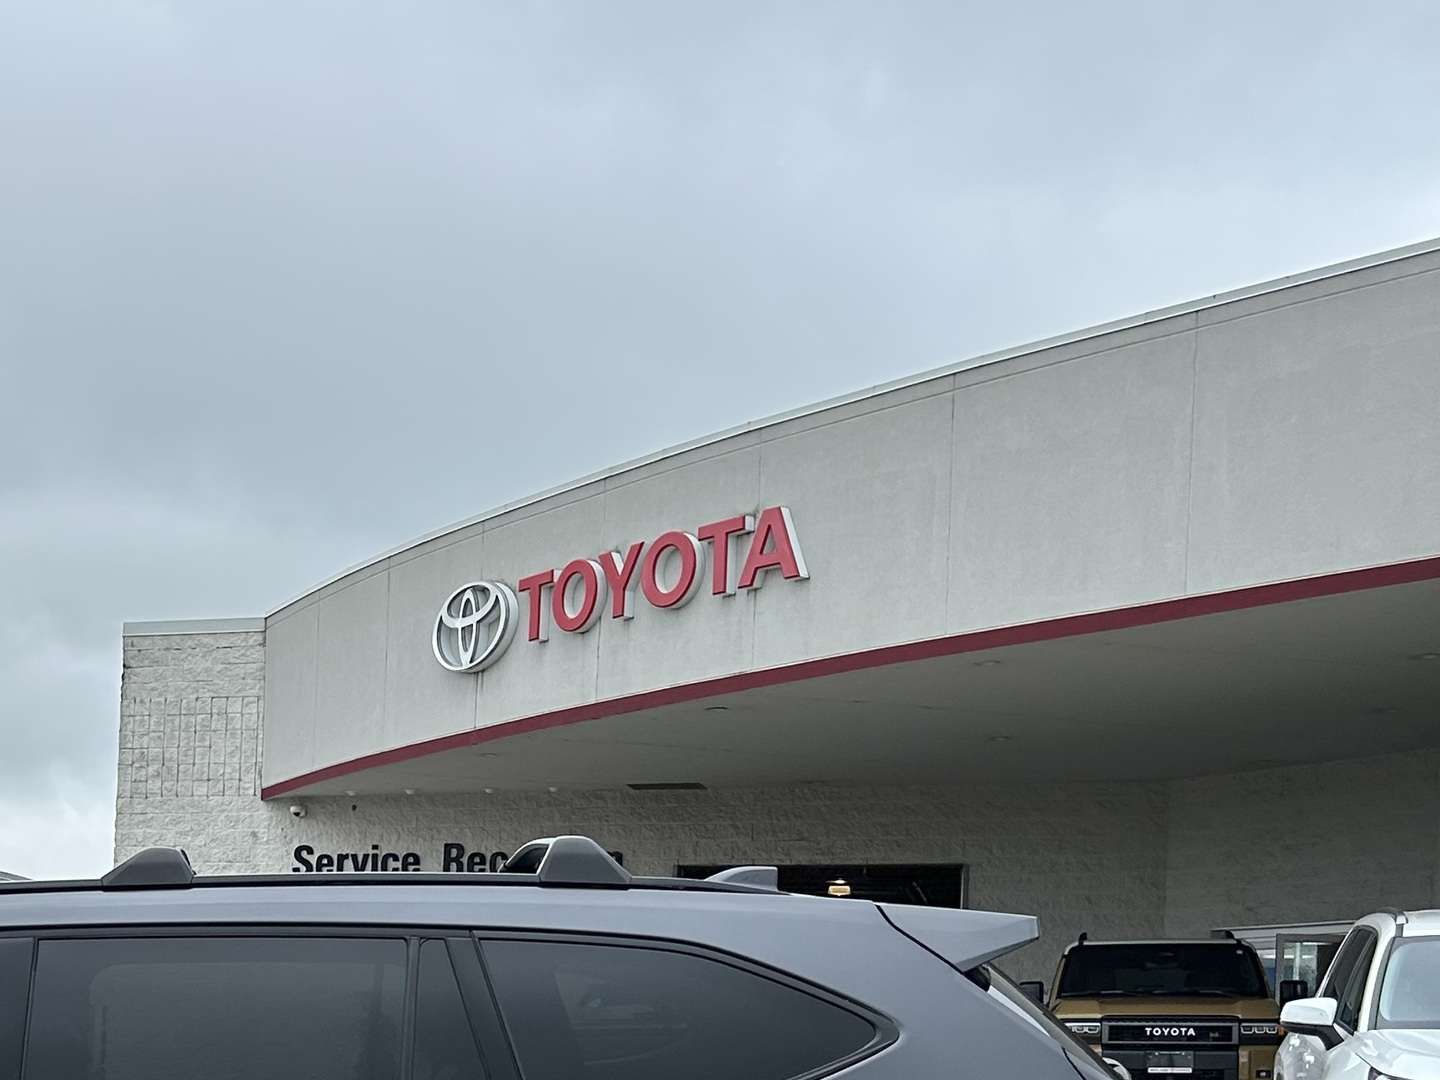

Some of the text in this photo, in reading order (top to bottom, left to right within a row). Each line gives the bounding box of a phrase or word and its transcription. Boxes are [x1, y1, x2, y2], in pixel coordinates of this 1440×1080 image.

[518, 506, 809, 643] TOYOTA
[292, 844, 420, 873] Service
[1145, 1027, 1196, 1036] TOYOTA
